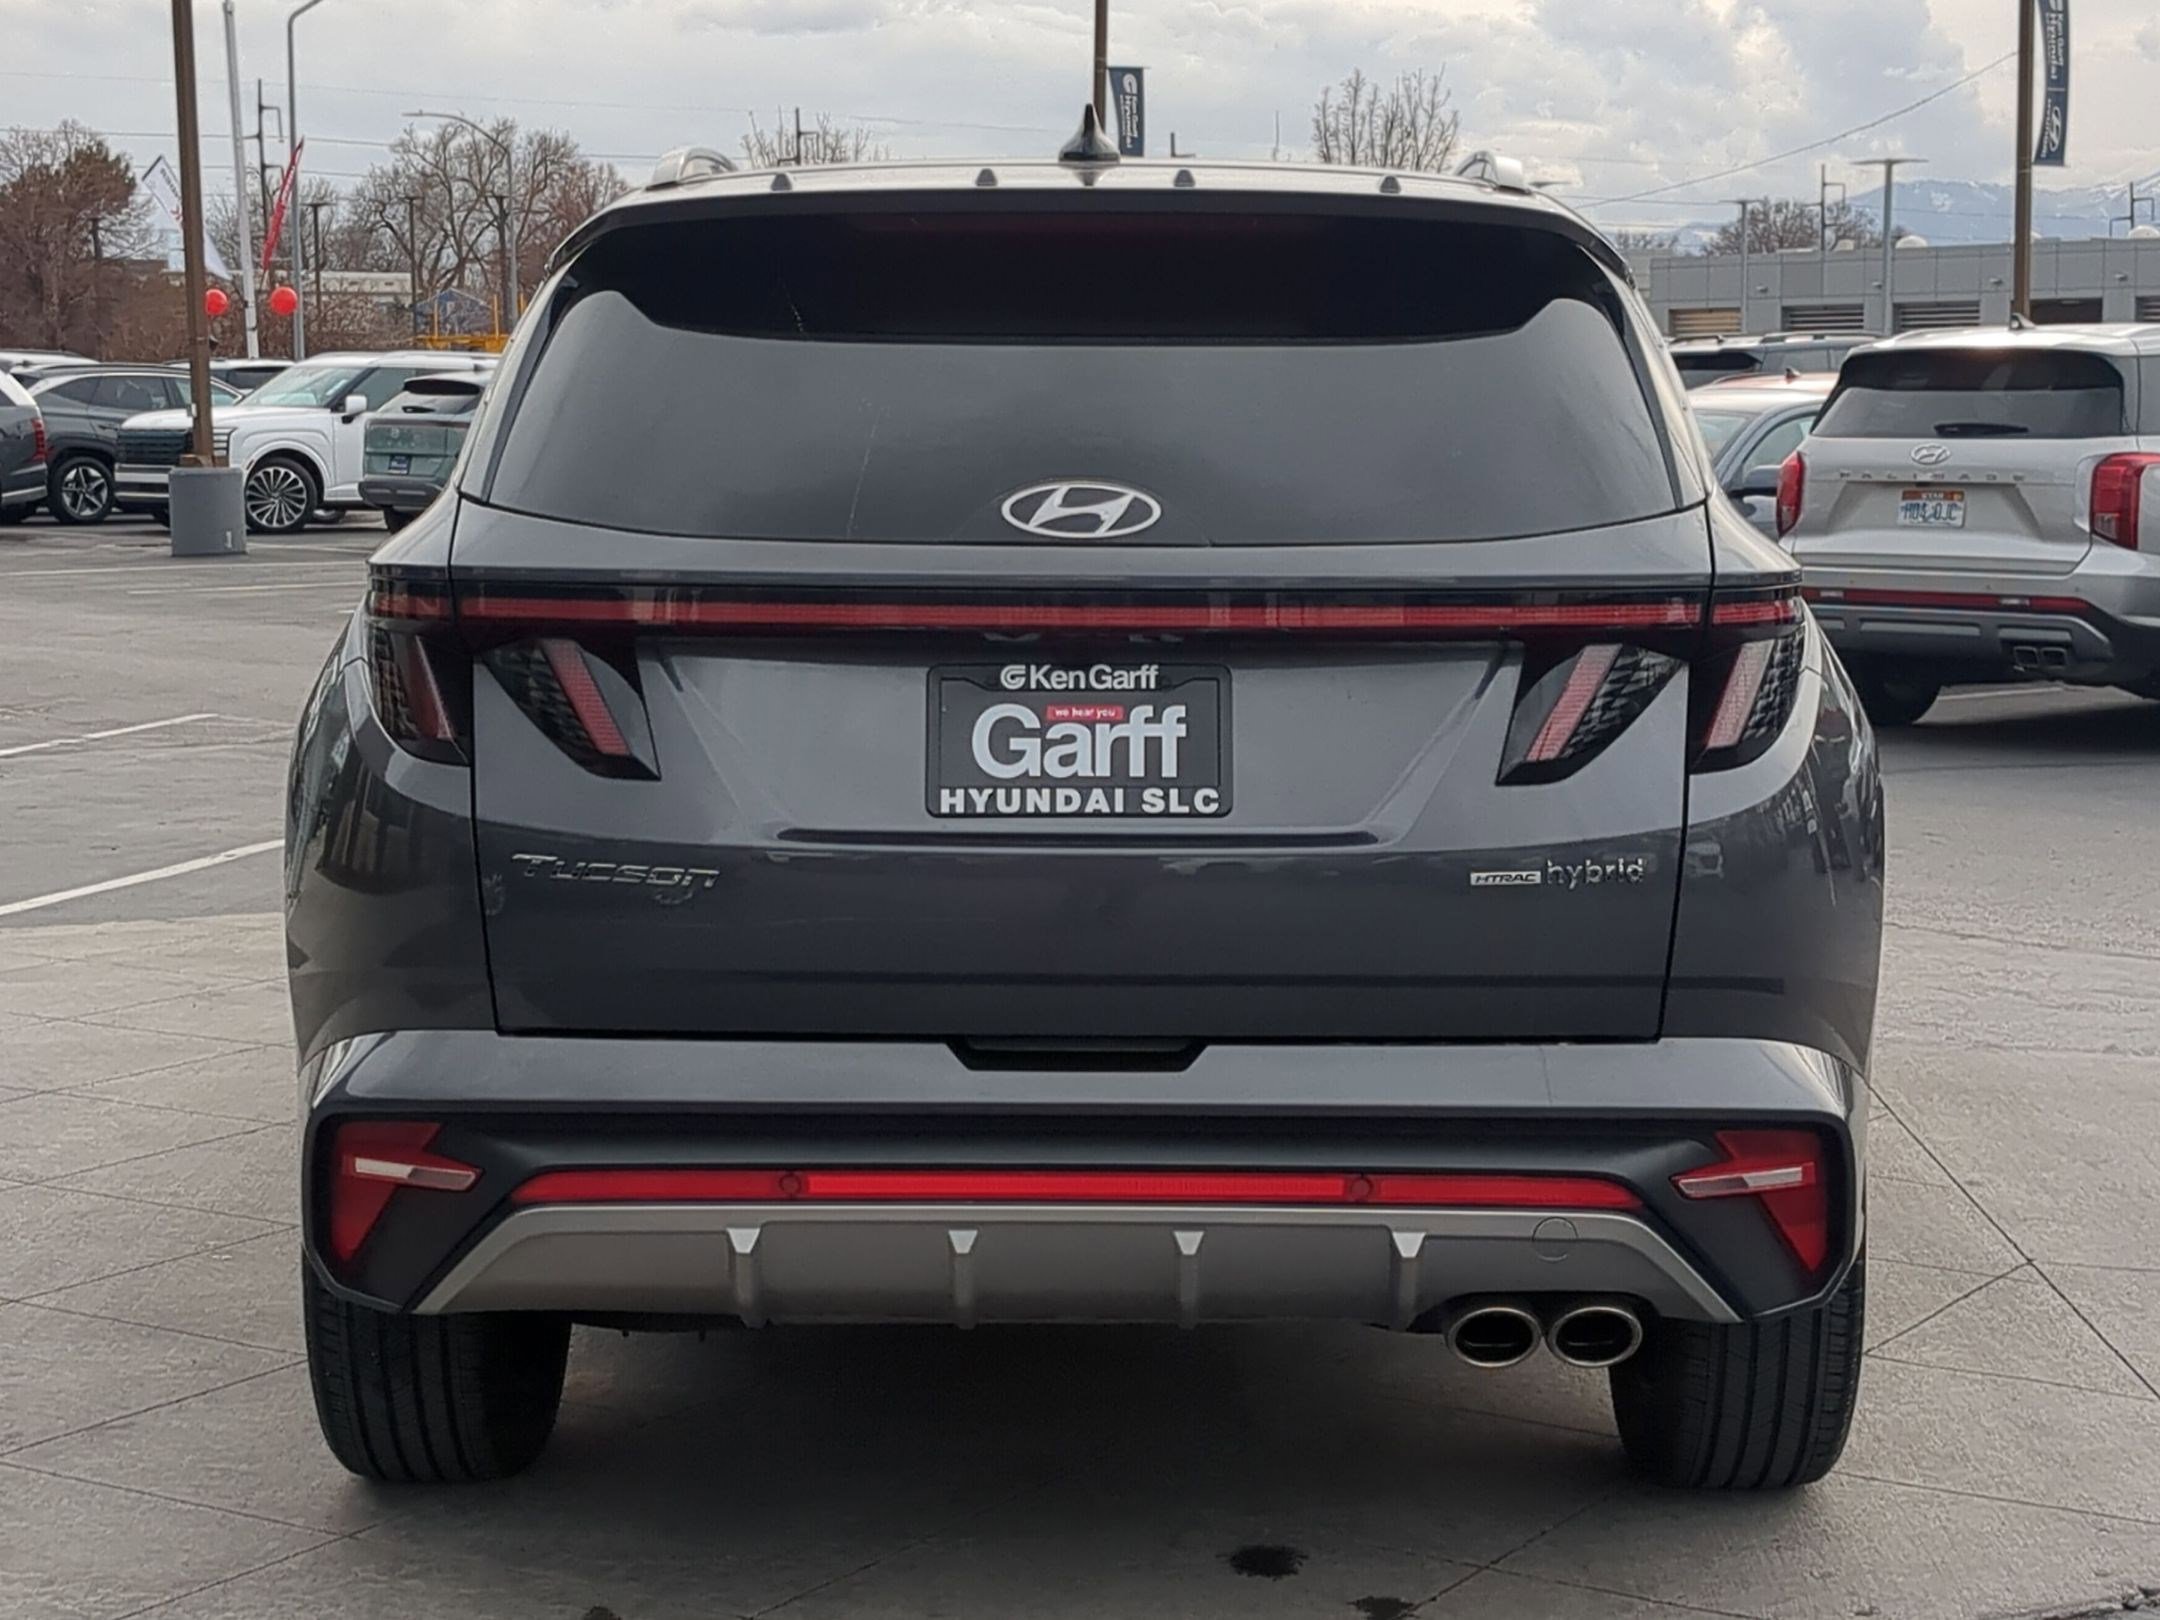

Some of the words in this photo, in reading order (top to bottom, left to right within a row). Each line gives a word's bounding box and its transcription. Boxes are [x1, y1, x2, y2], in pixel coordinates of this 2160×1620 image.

[1029, 664, 1086, 690] Ken
[1089, 663, 1159, 690] Garff
[1055, 708, 1069, 717] we
[1072, 706, 1094, 717] hear
[1096, 708, 1116, 719] you
[971, 703, 1187, 779] Garff
[940, 788, 1125, 814] HYUNDAI
[1141, 787, 1219, 814] SLC
[1473, 872, 1539, 885] HTRAC
[1547, 858, 1645, 890] hybrid
